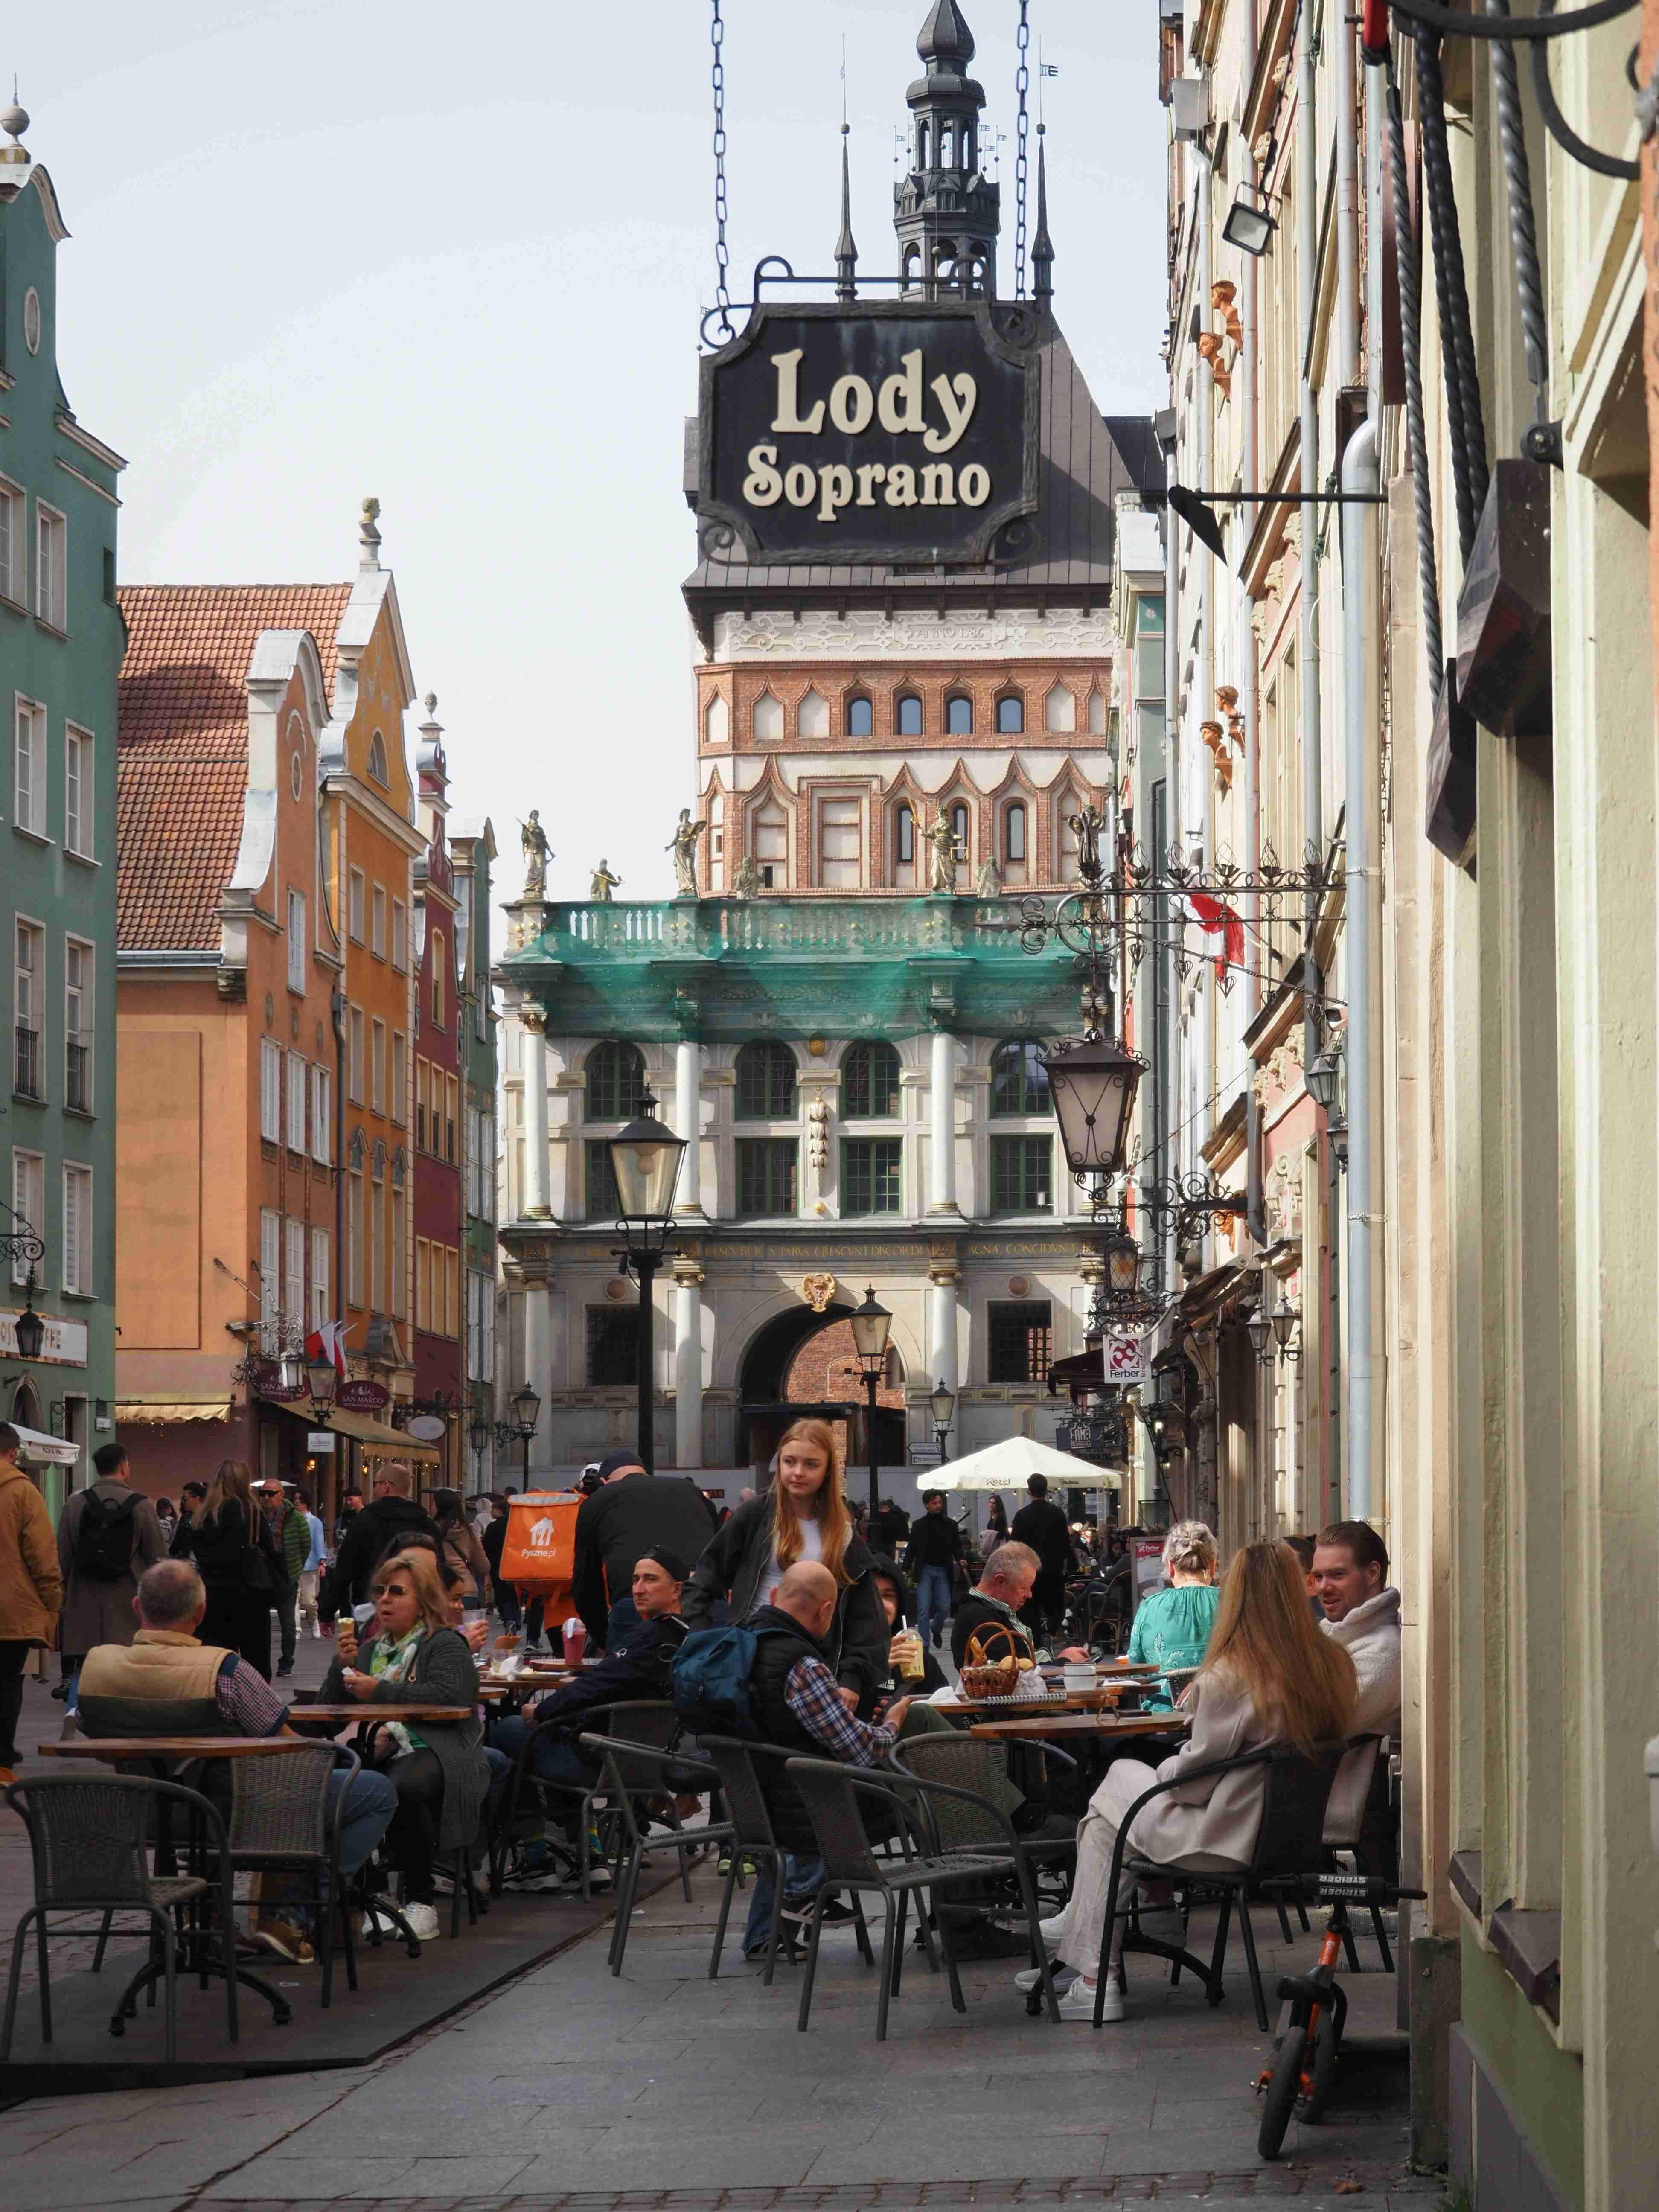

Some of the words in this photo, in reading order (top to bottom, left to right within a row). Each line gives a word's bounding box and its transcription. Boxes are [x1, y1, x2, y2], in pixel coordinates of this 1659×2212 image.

[770, 348, 977, 454] Lody
[742, 445, 992, 523] Soprano
[917, 627, 956, 639] ANNO
[1110, 1369, 1140, 1378] Ferber
[986, 1478, 1011, 1486] Kozel
[522, 1548, 556, 1560] Pyszne.pl
[1319, 1875, 1366, 1884] STRIDER
[1319, 1887, 1366, 1897] STRIDER
